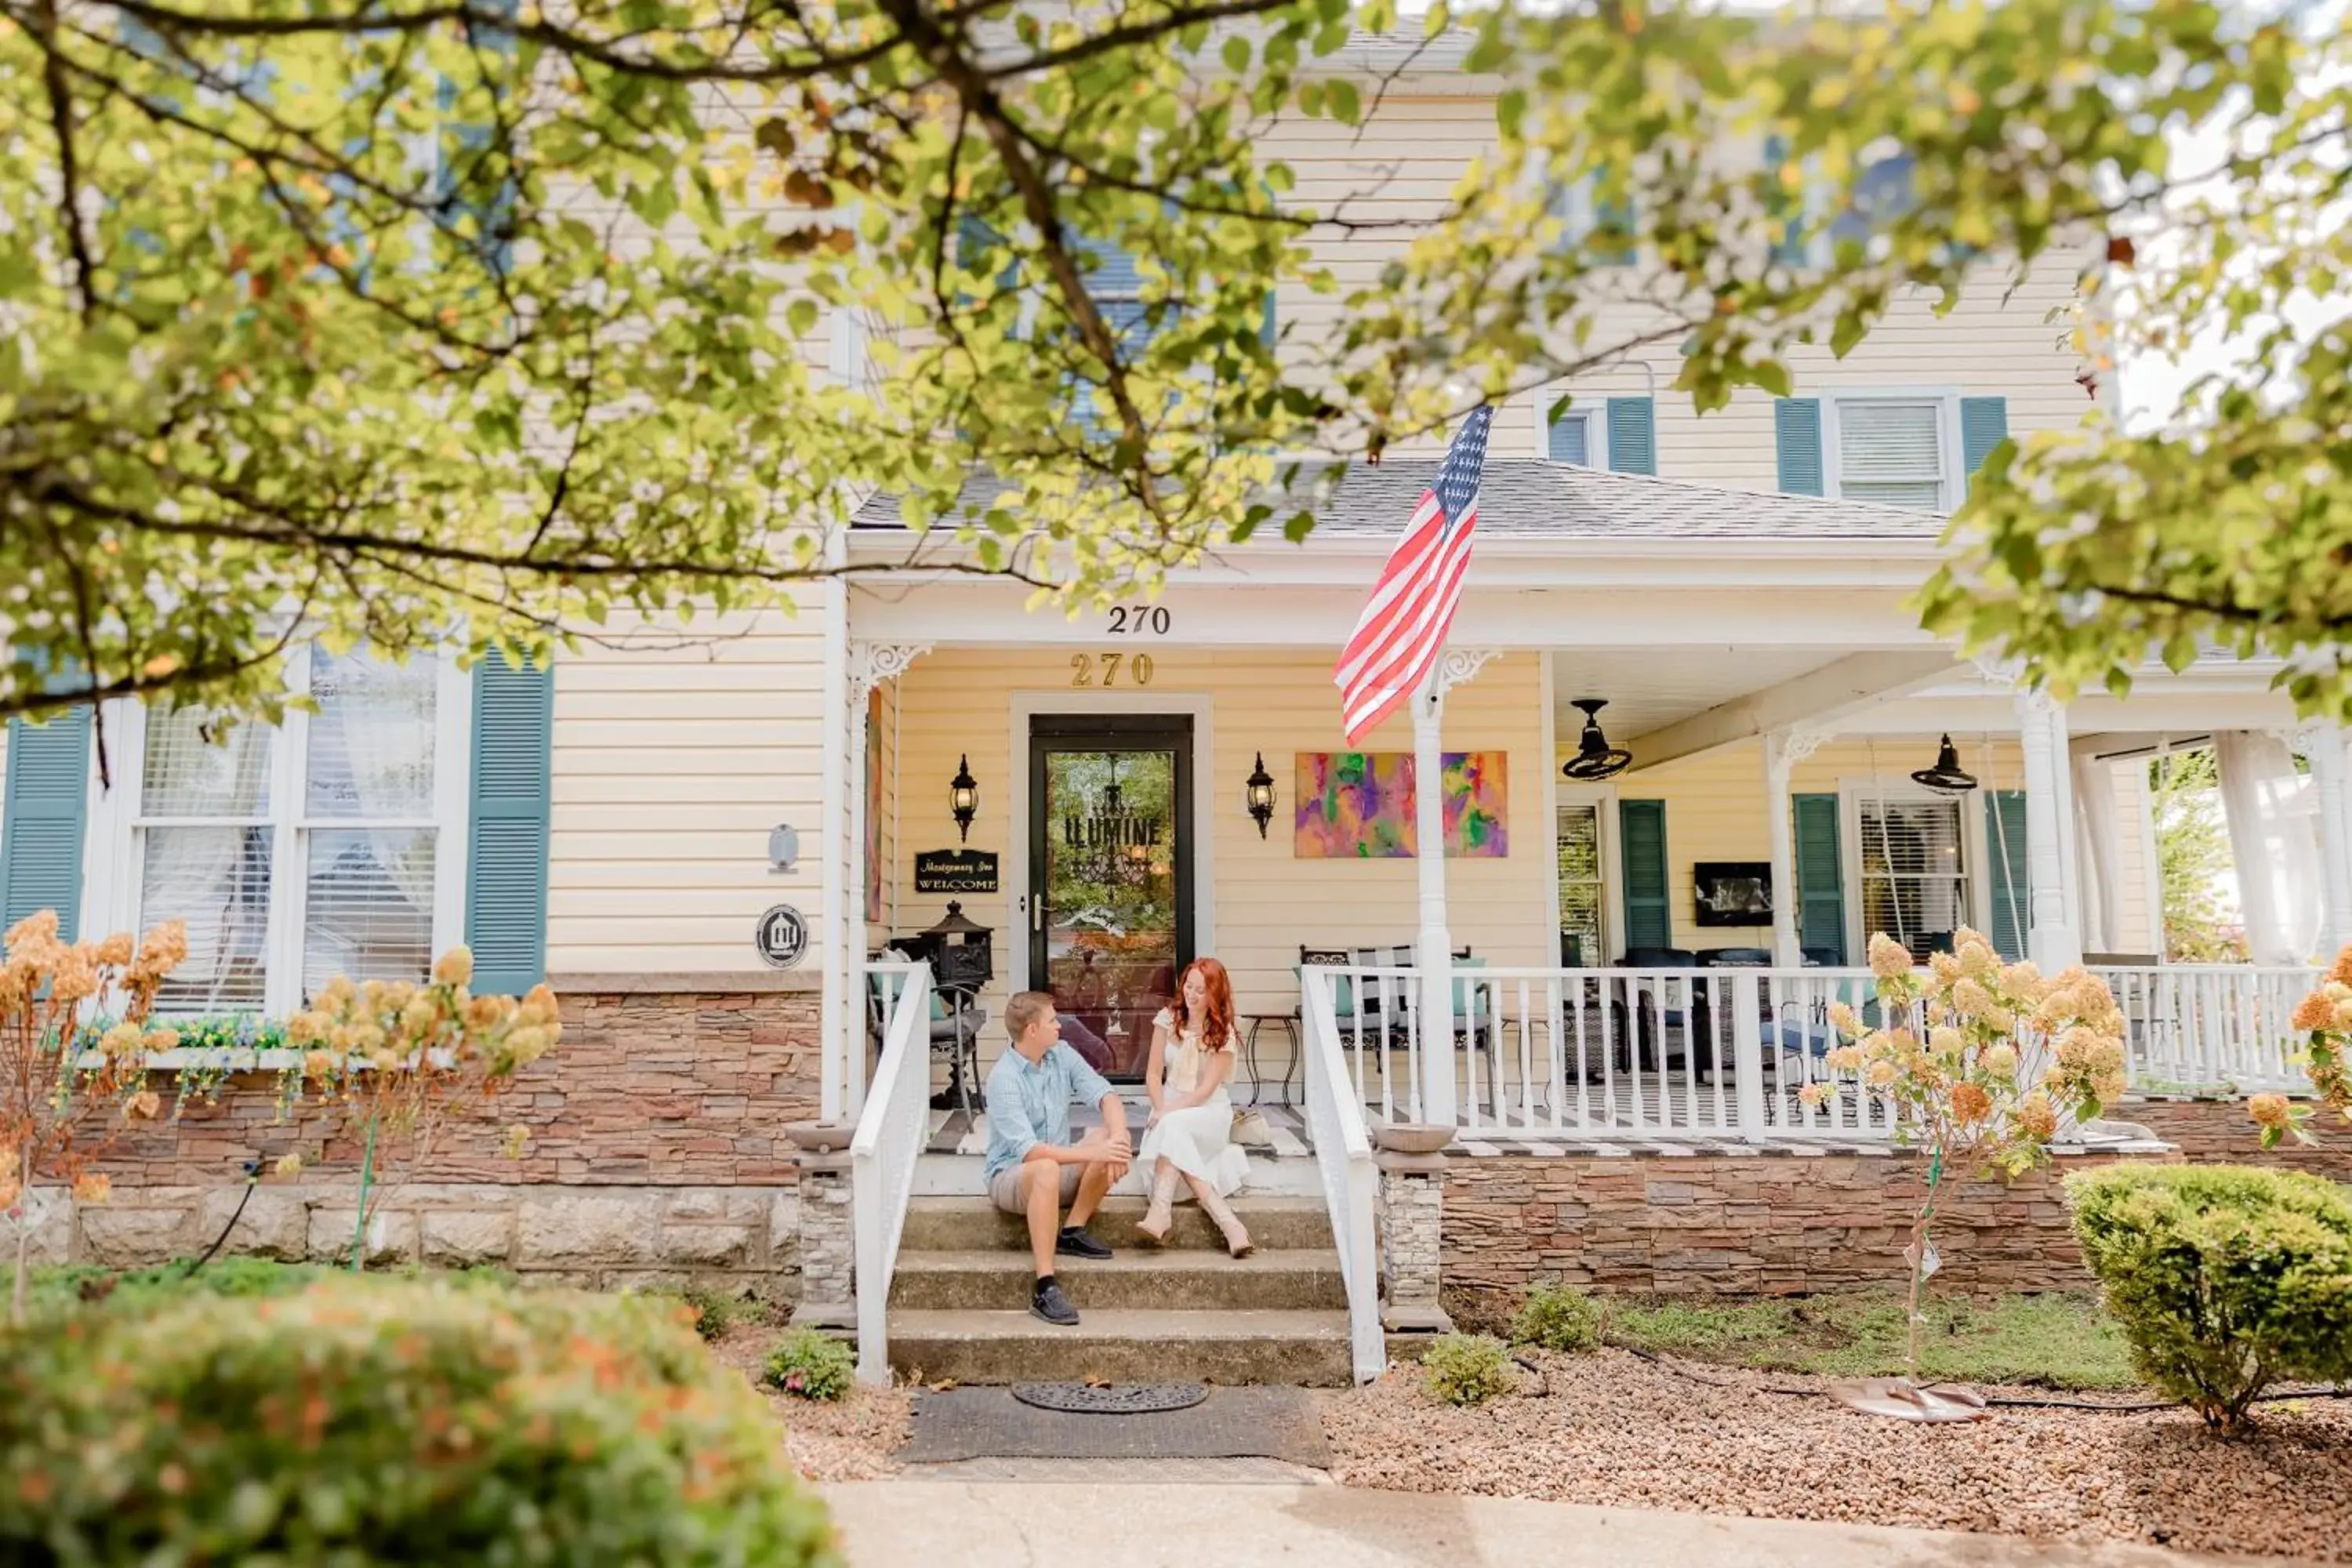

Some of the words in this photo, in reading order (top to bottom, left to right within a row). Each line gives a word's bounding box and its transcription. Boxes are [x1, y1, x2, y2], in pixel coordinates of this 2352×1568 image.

[1107, 604, 1171, 634] 270
[1070, 652, 1154, 687] 270
[920, 858, 974, 874] Montgomery
[919, 879, 998, 890] WELCOME
